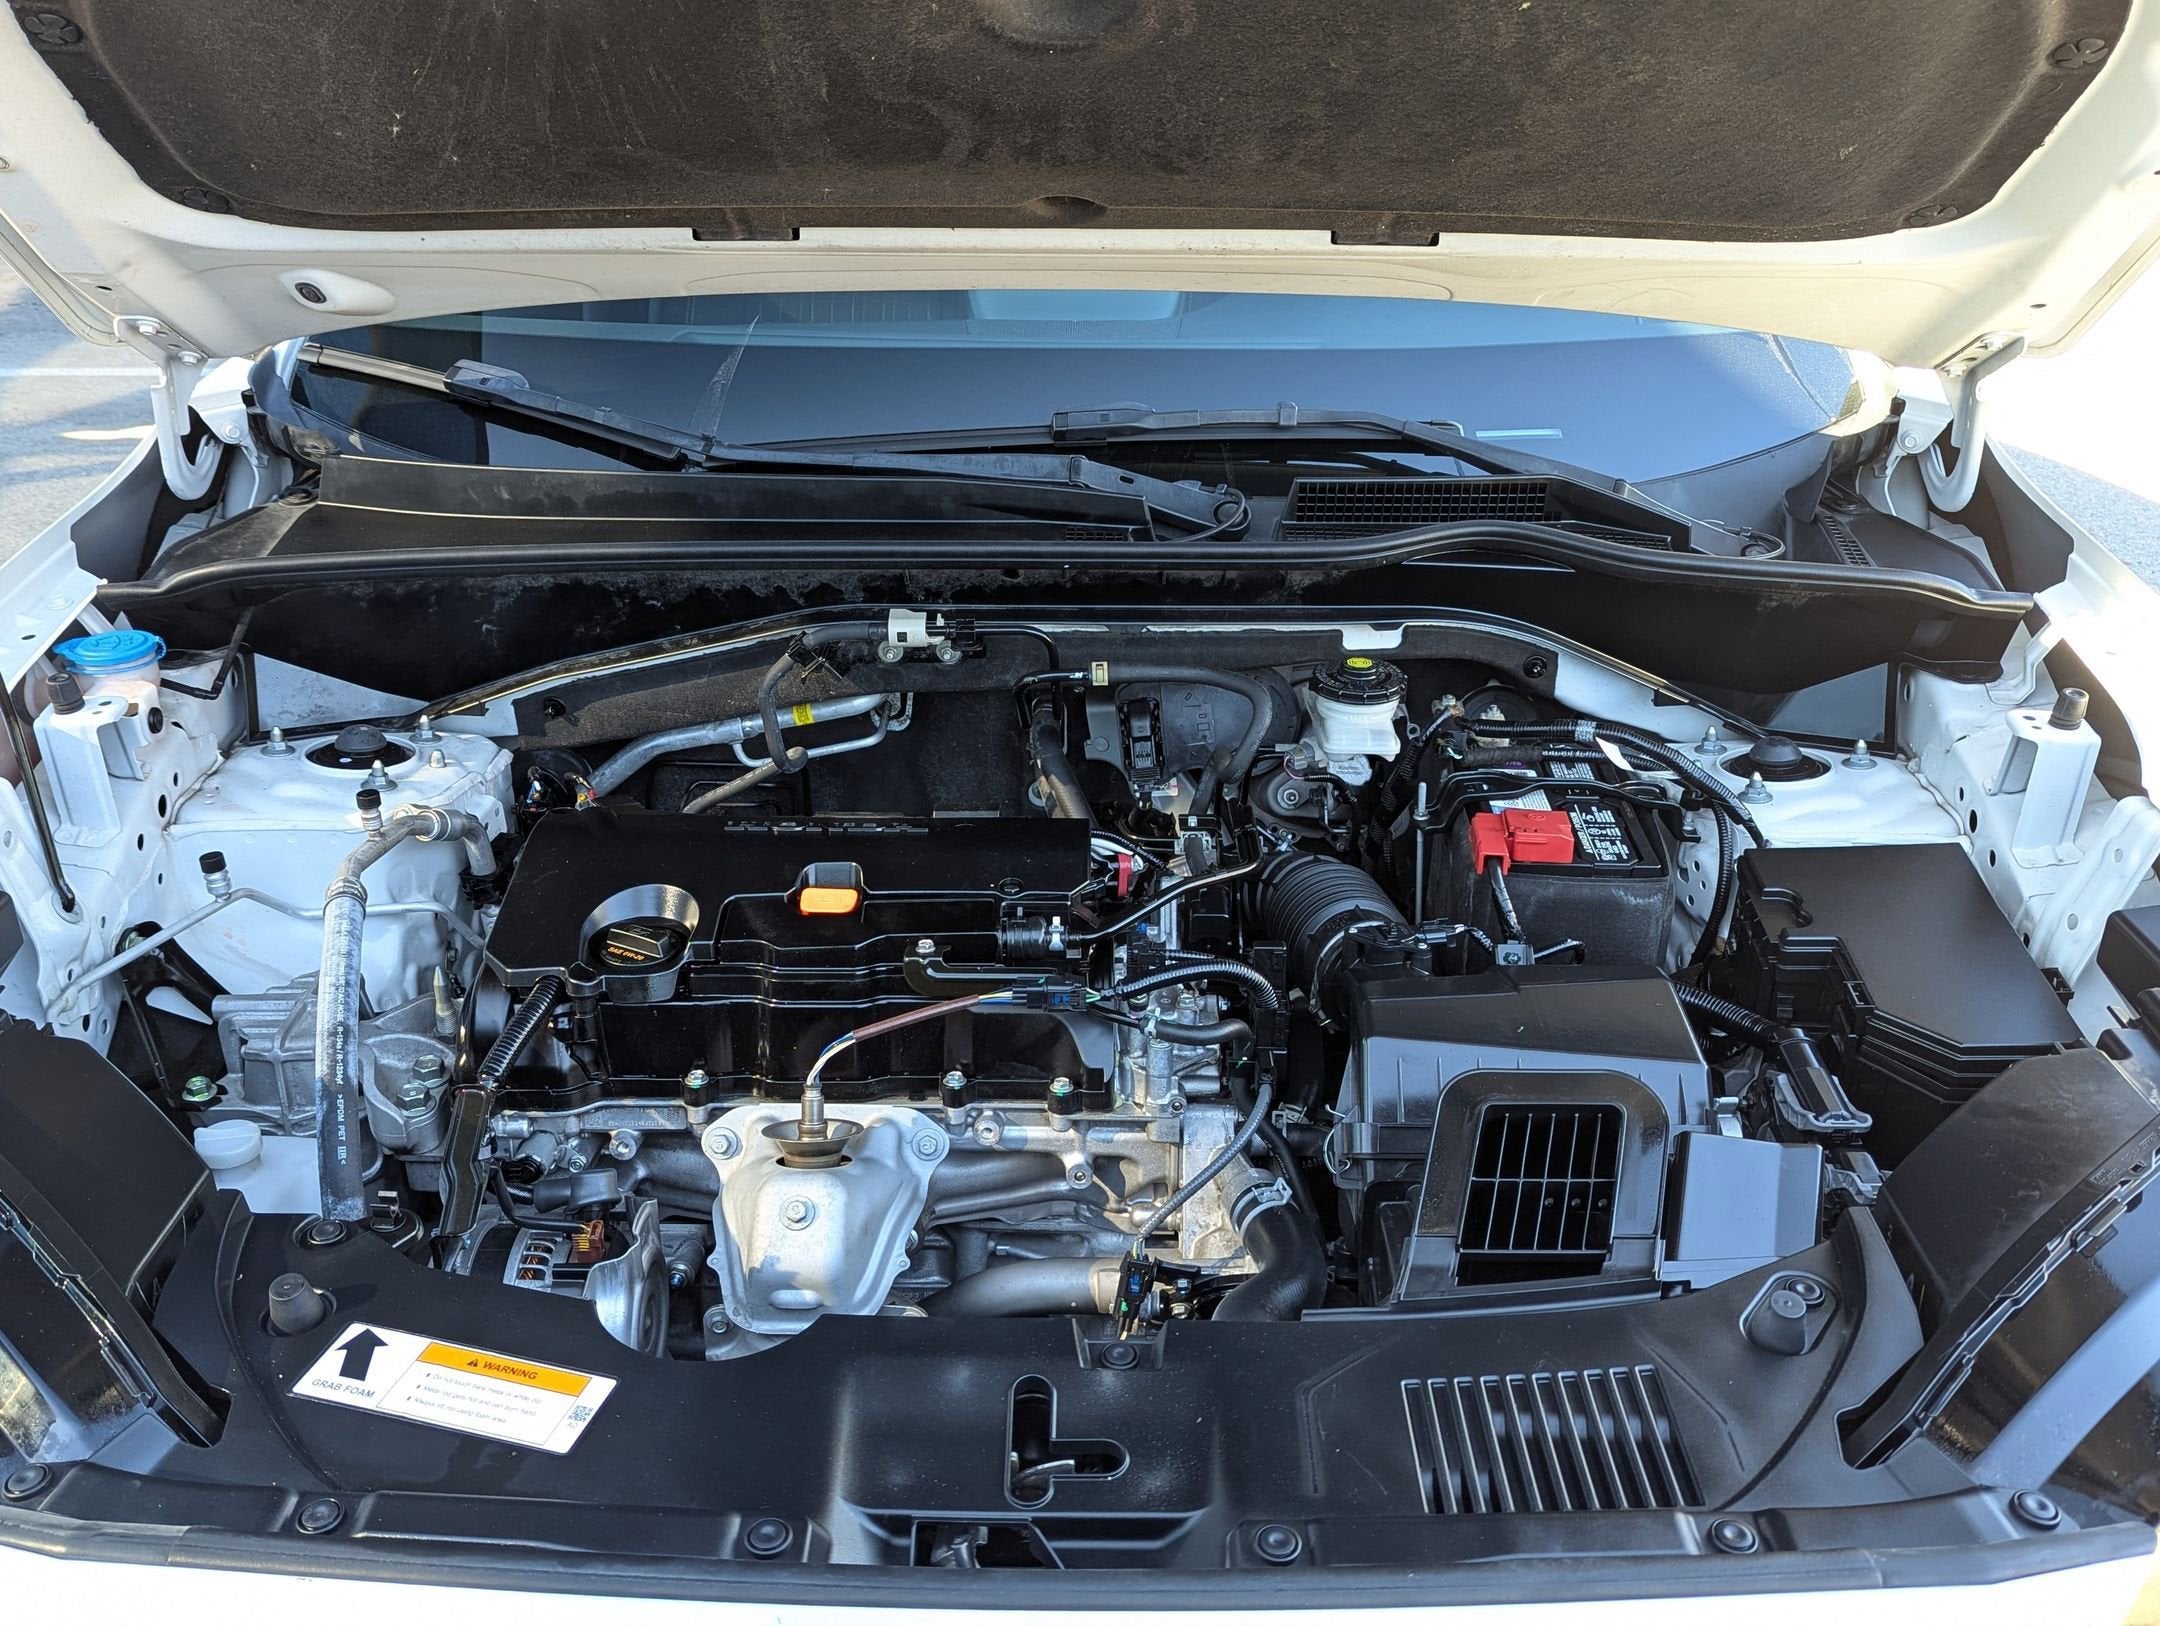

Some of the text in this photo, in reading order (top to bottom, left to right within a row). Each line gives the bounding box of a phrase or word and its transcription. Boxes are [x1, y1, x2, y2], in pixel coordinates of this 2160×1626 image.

[608, 946, 624, 955] SAE
[337, 1125, 346, 1142] PET
[483, 1361, 538, 1380] WARNING
[312, 1379, 375, 1398] GRAB FOAM
